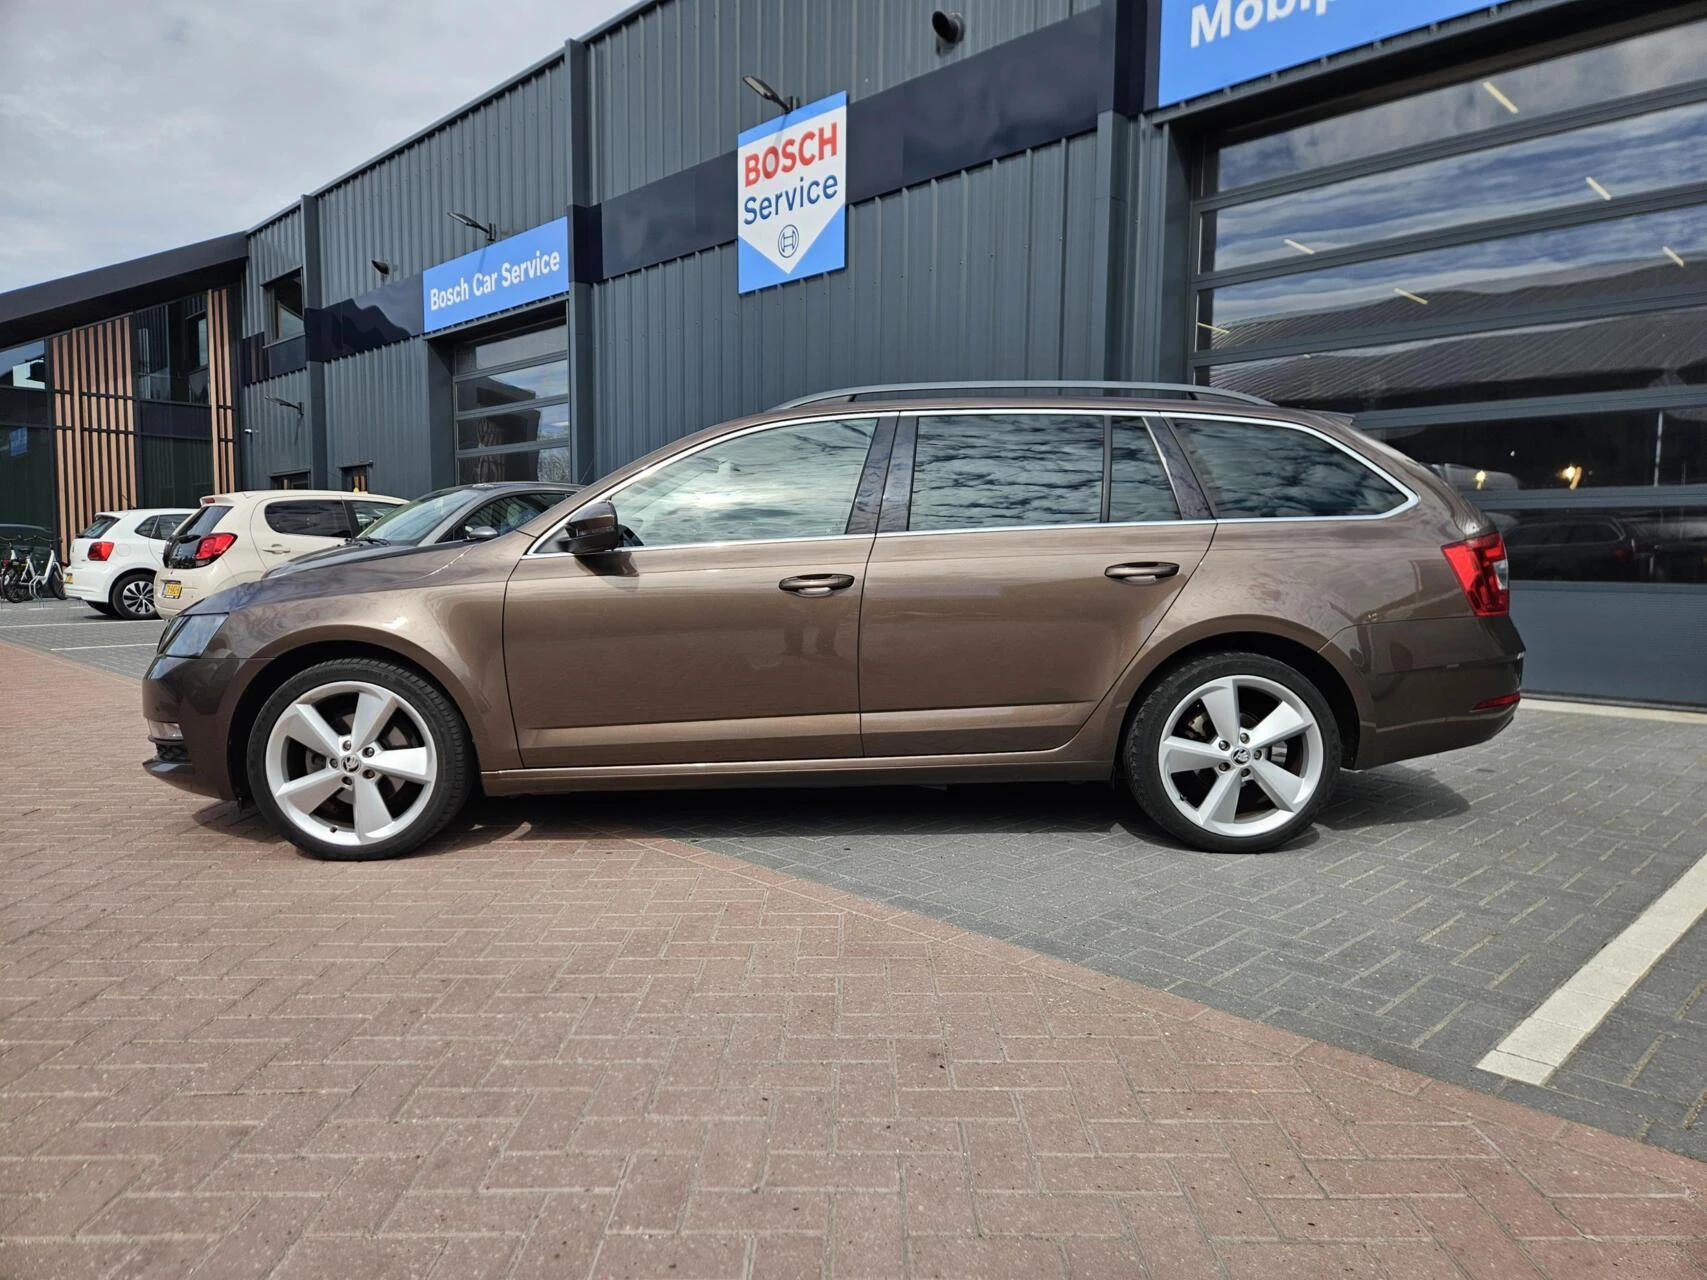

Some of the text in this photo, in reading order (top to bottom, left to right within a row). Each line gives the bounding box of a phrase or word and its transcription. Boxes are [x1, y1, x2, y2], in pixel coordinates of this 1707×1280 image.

[1190, 0, 1337, 48] Mob
[744, 121, 838, 188] BOSCH
[743, 174, 839, 226] Service
[430, 250, 561, 311] Bosch Car Service
